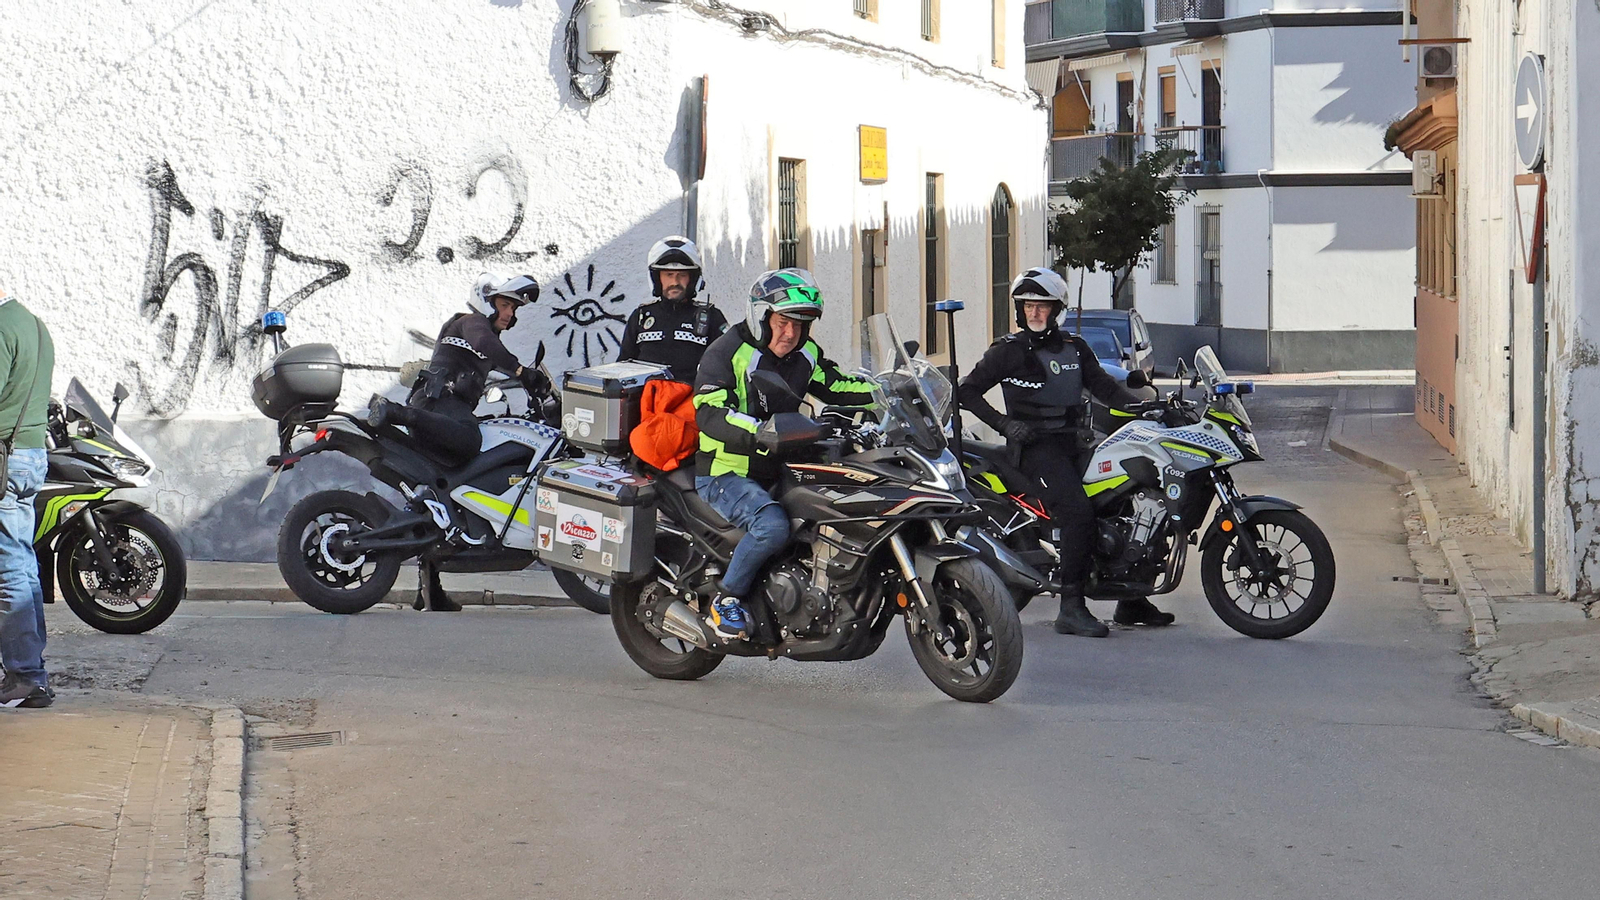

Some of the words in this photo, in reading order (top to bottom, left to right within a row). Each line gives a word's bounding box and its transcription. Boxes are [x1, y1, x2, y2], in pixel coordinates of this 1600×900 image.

[523, 437, 541, 449] LOCAL
[1169, 468, 1186, 479] 092
[562, 521, 596, 540] Picazzo
